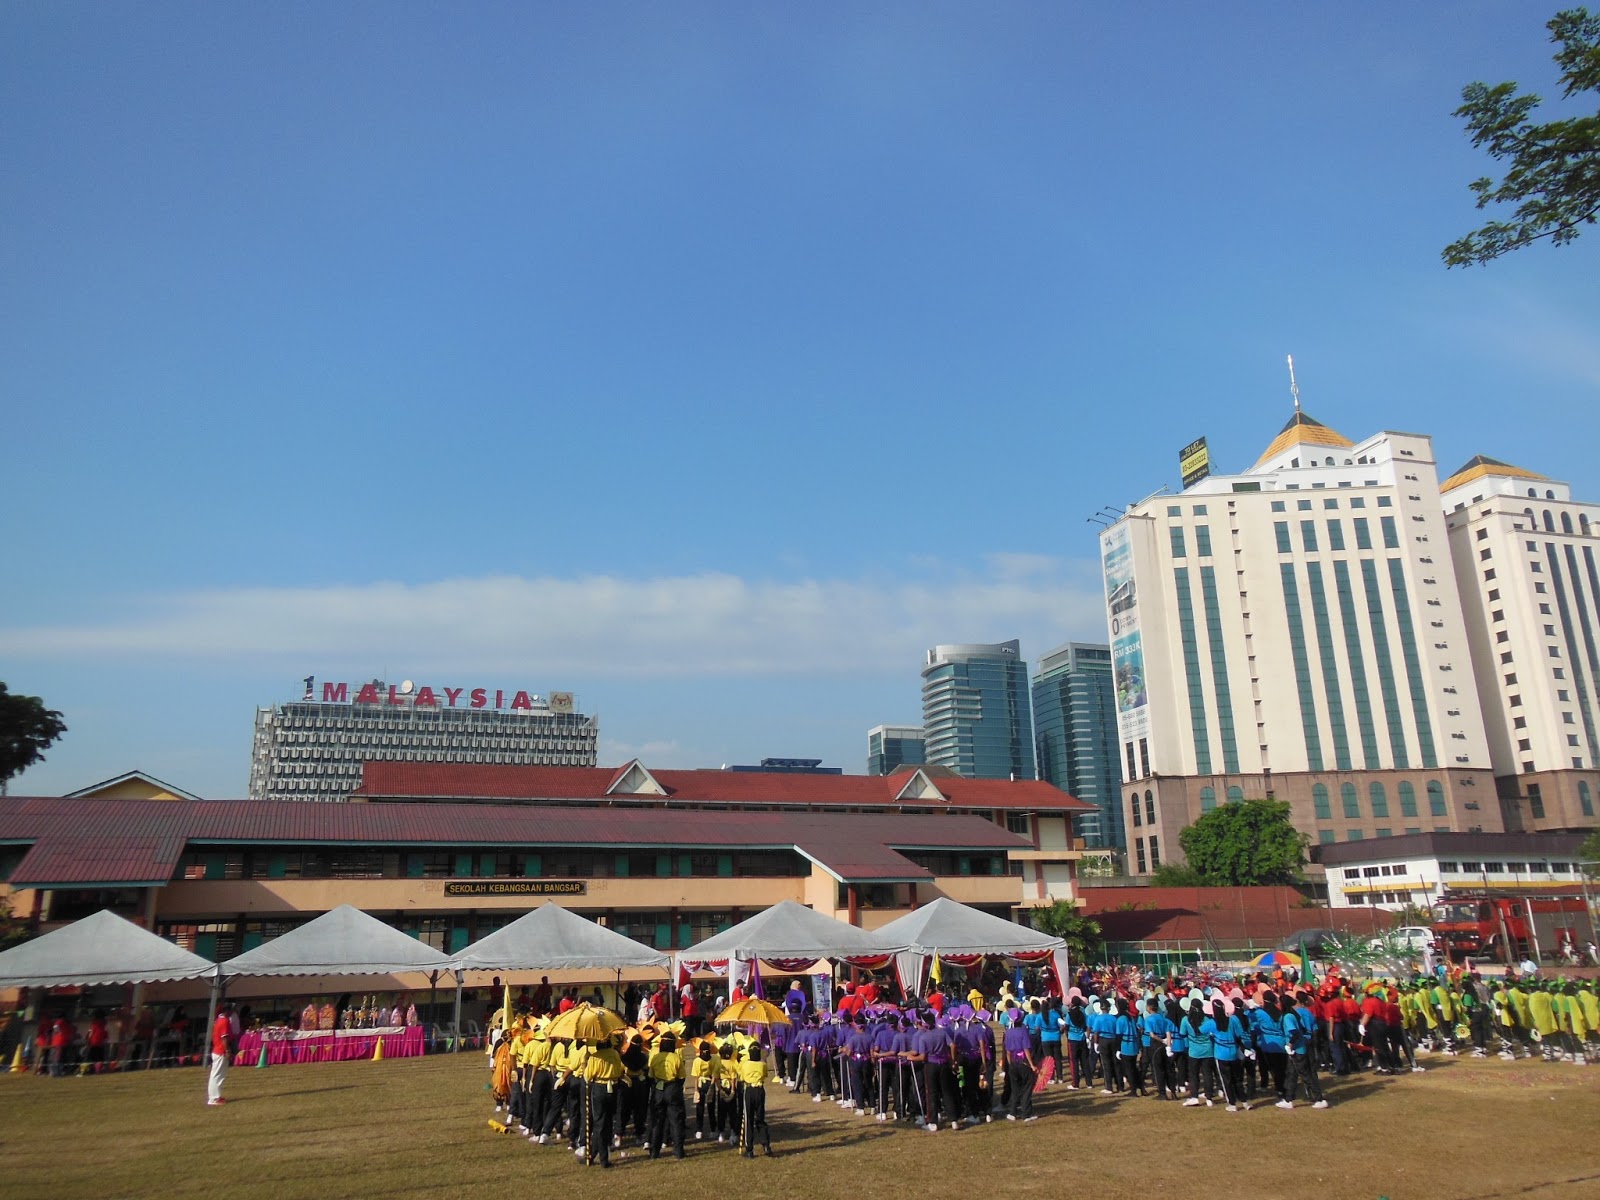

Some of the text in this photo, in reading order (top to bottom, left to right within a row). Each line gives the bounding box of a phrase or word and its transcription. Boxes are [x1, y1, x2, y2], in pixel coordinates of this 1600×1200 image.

[1114, 648, 1125, 660] RM
[449, 883, 580, 893] SEKOLAH KEBANGSAAN BANGSAR
